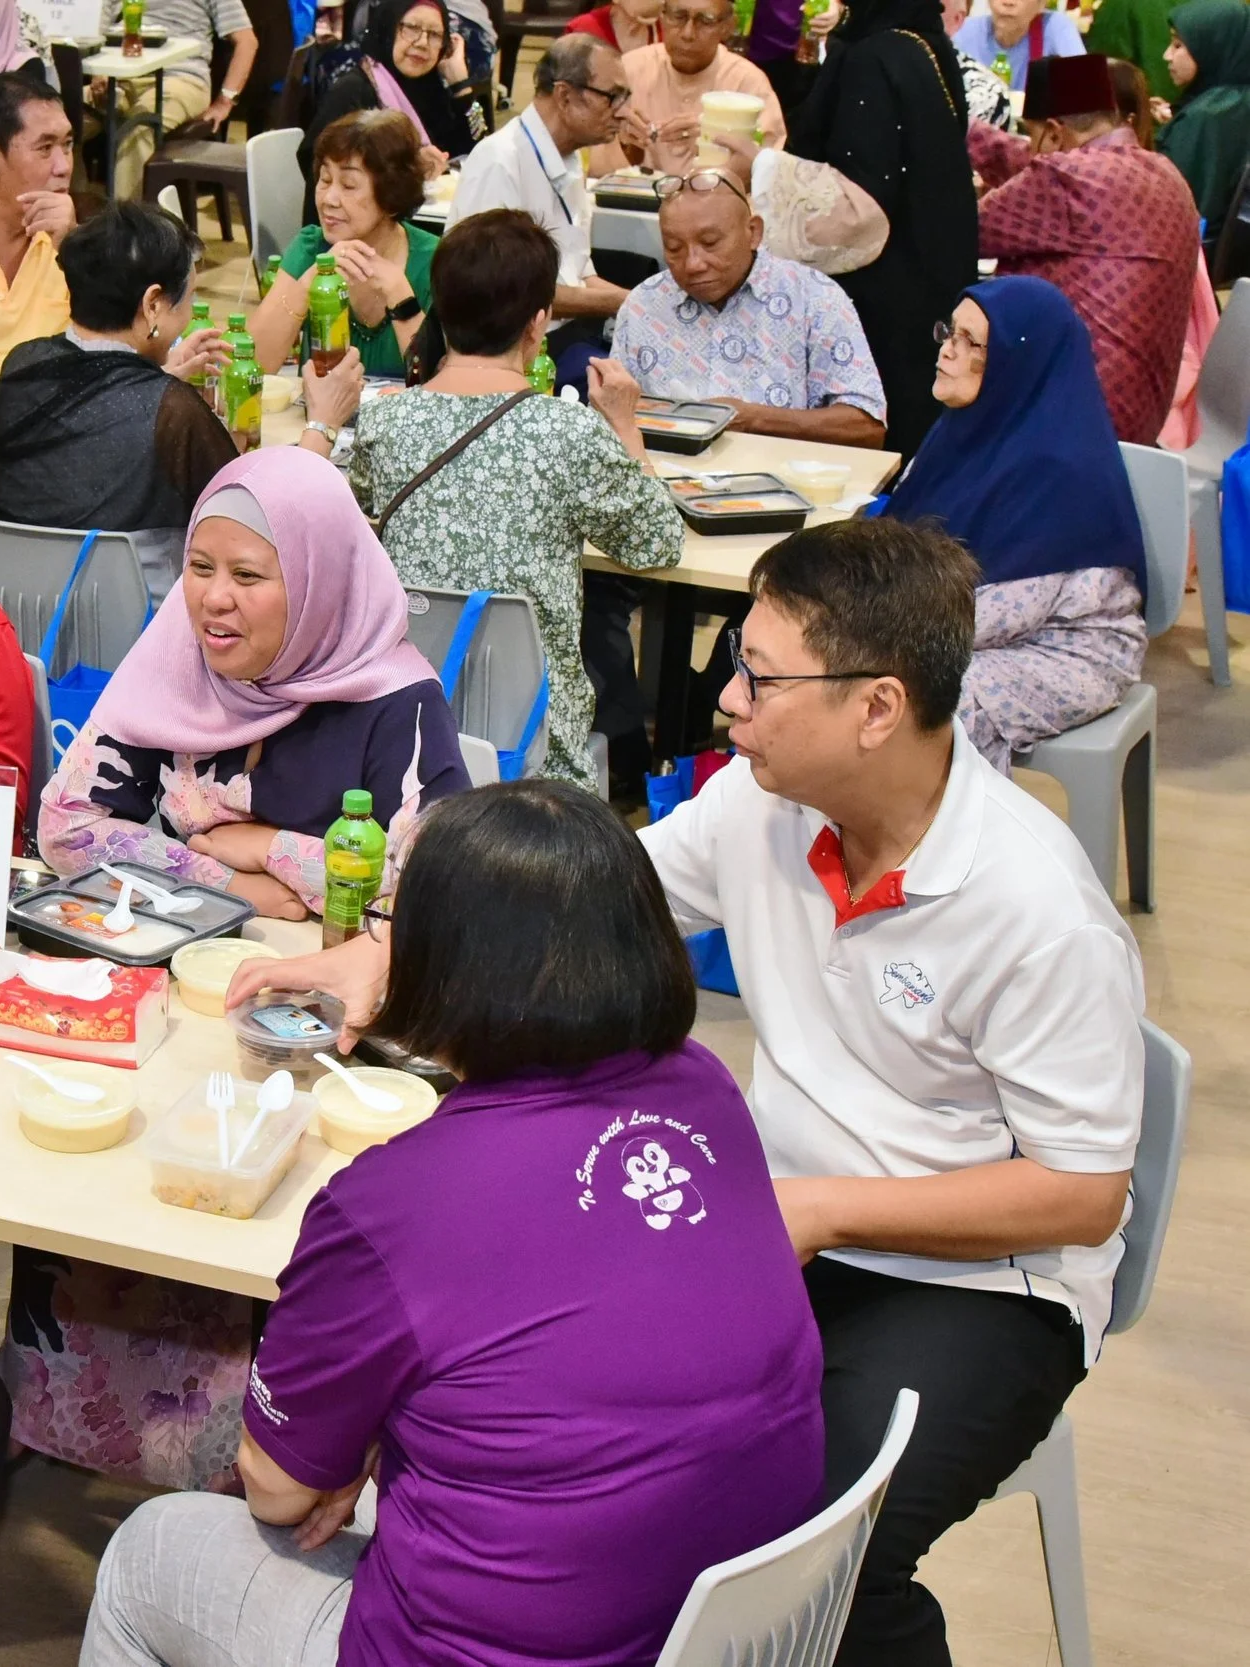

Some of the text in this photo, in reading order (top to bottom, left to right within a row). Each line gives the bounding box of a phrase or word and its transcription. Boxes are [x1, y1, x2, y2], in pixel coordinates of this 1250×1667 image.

[884, 963, 934, 1005] Sembawang
[575, 1109, 717, 1212] To Serve with Love and Care
